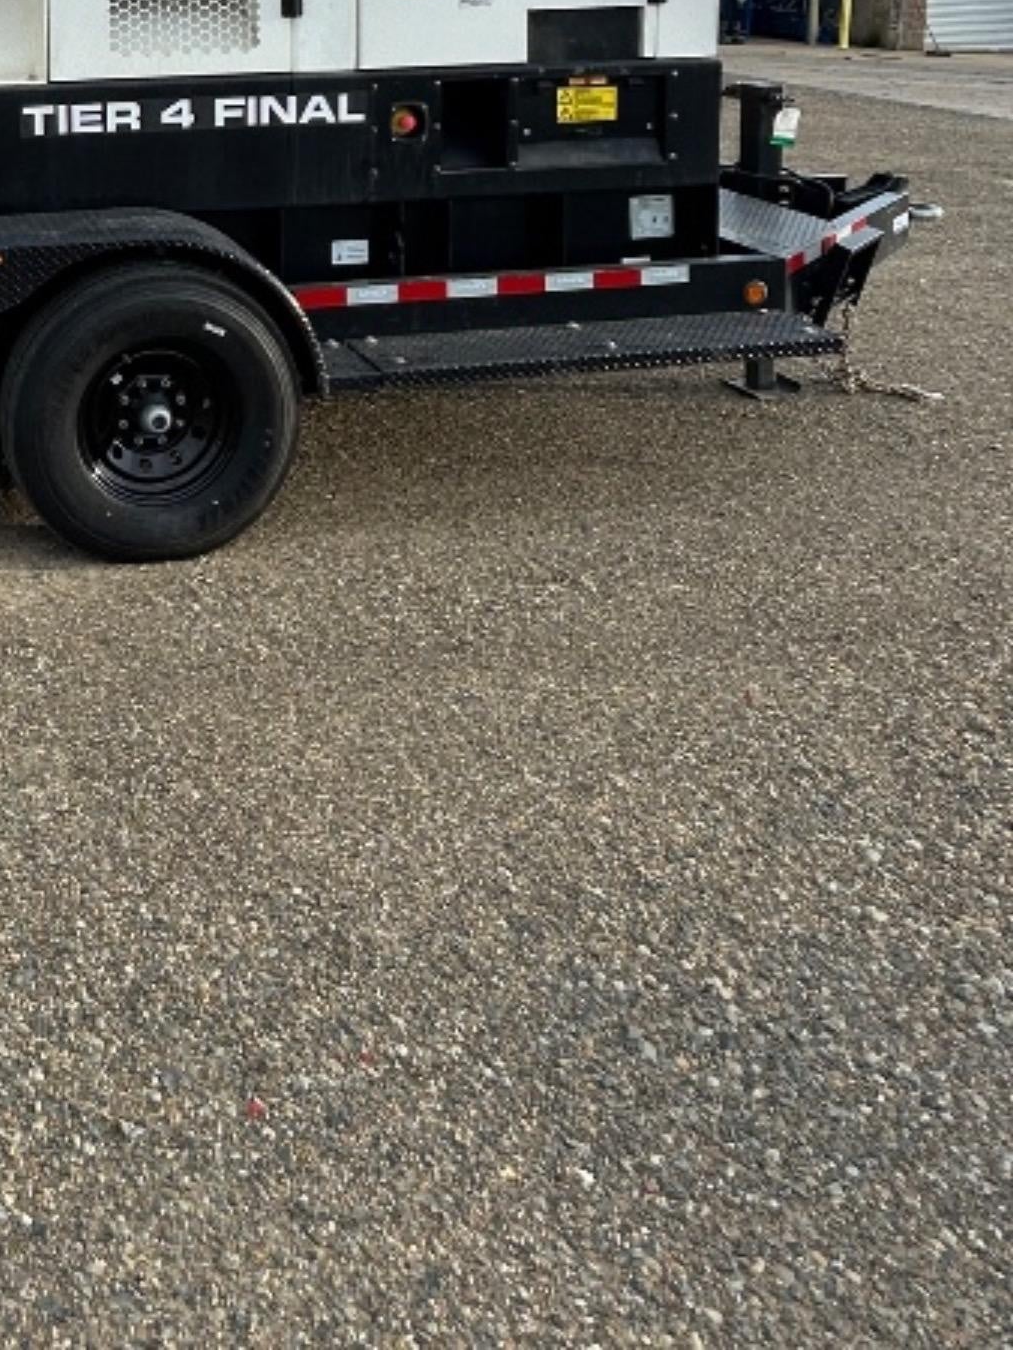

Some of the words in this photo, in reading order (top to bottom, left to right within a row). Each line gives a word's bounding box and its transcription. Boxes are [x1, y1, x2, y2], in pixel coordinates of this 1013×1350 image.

[22, 101, 142, 137] TIER
[160, 98, 195, 130] 4
[213, 92, 366, 128] FINAL
